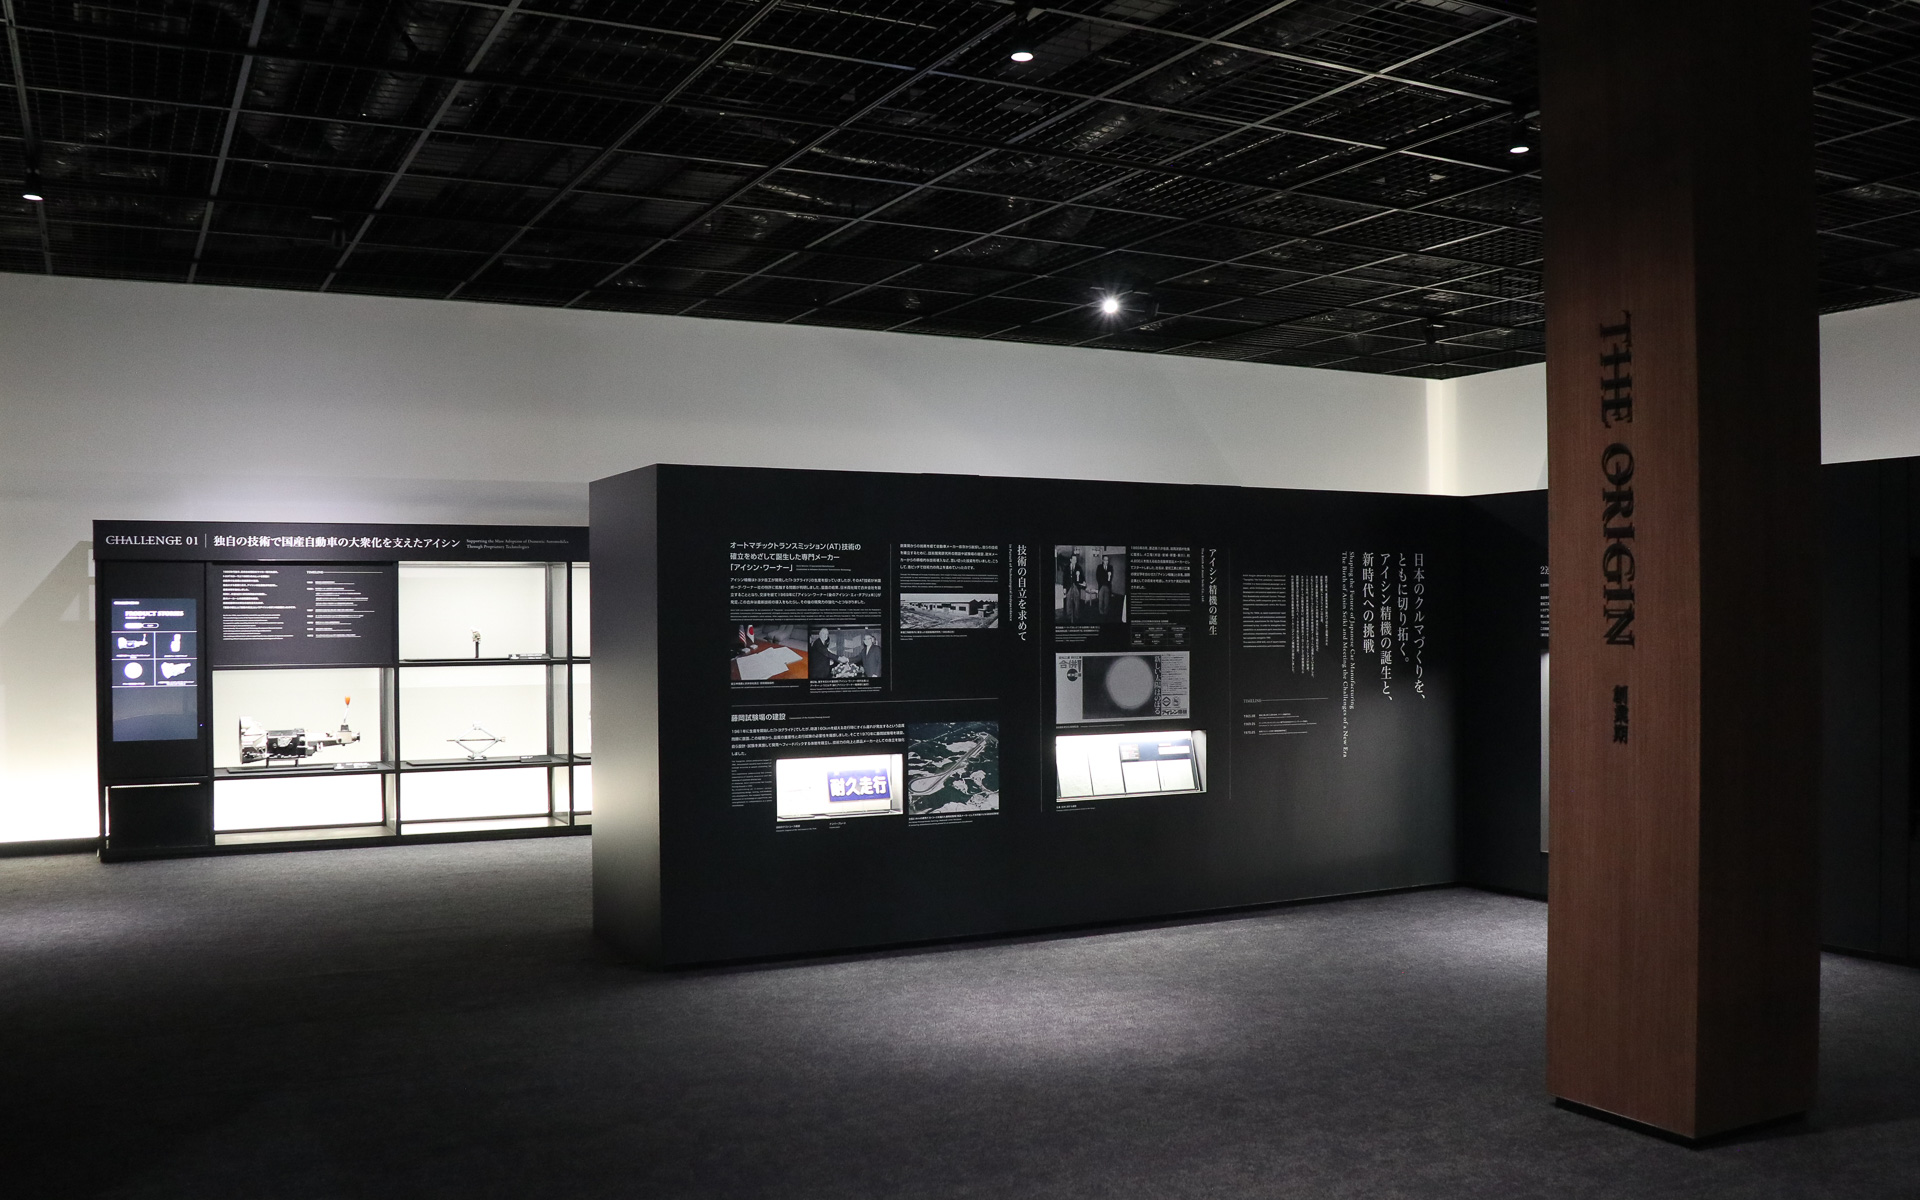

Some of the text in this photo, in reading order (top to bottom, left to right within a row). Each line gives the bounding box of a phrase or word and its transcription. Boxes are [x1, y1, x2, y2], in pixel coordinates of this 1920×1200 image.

[1600, 310, 1635, 648] THE ORIGIN
[105, 536, 198, 545] CHALLENGE 01
[213, 535, 461, 550] 独自の技術で国産自動車の大衆化を支えたアイシン
[730, 553, 840, 561] 確立をめざして誕生した専門メーカー
[1017, 544, 1028, 641] 技術の自立を求めて
[1208, 548, 1218, 636] アイシン精機の誕生
[1342, 584, 1348, 592] of
[1362, 552, 1375, 654] 新時代への挑戦
[1397, 553, 1410, 663] ともに切り拓く。
[1349, 612, 1355, 620] of
[1380, 553, 1393, 701] アイシン精機の誕生と、
[1413, 553, 1426, 699] 日本のクルマづくりを、
[1343, 717, 1349, 725] of
[829, 776, 887, 797] 耐久走行
